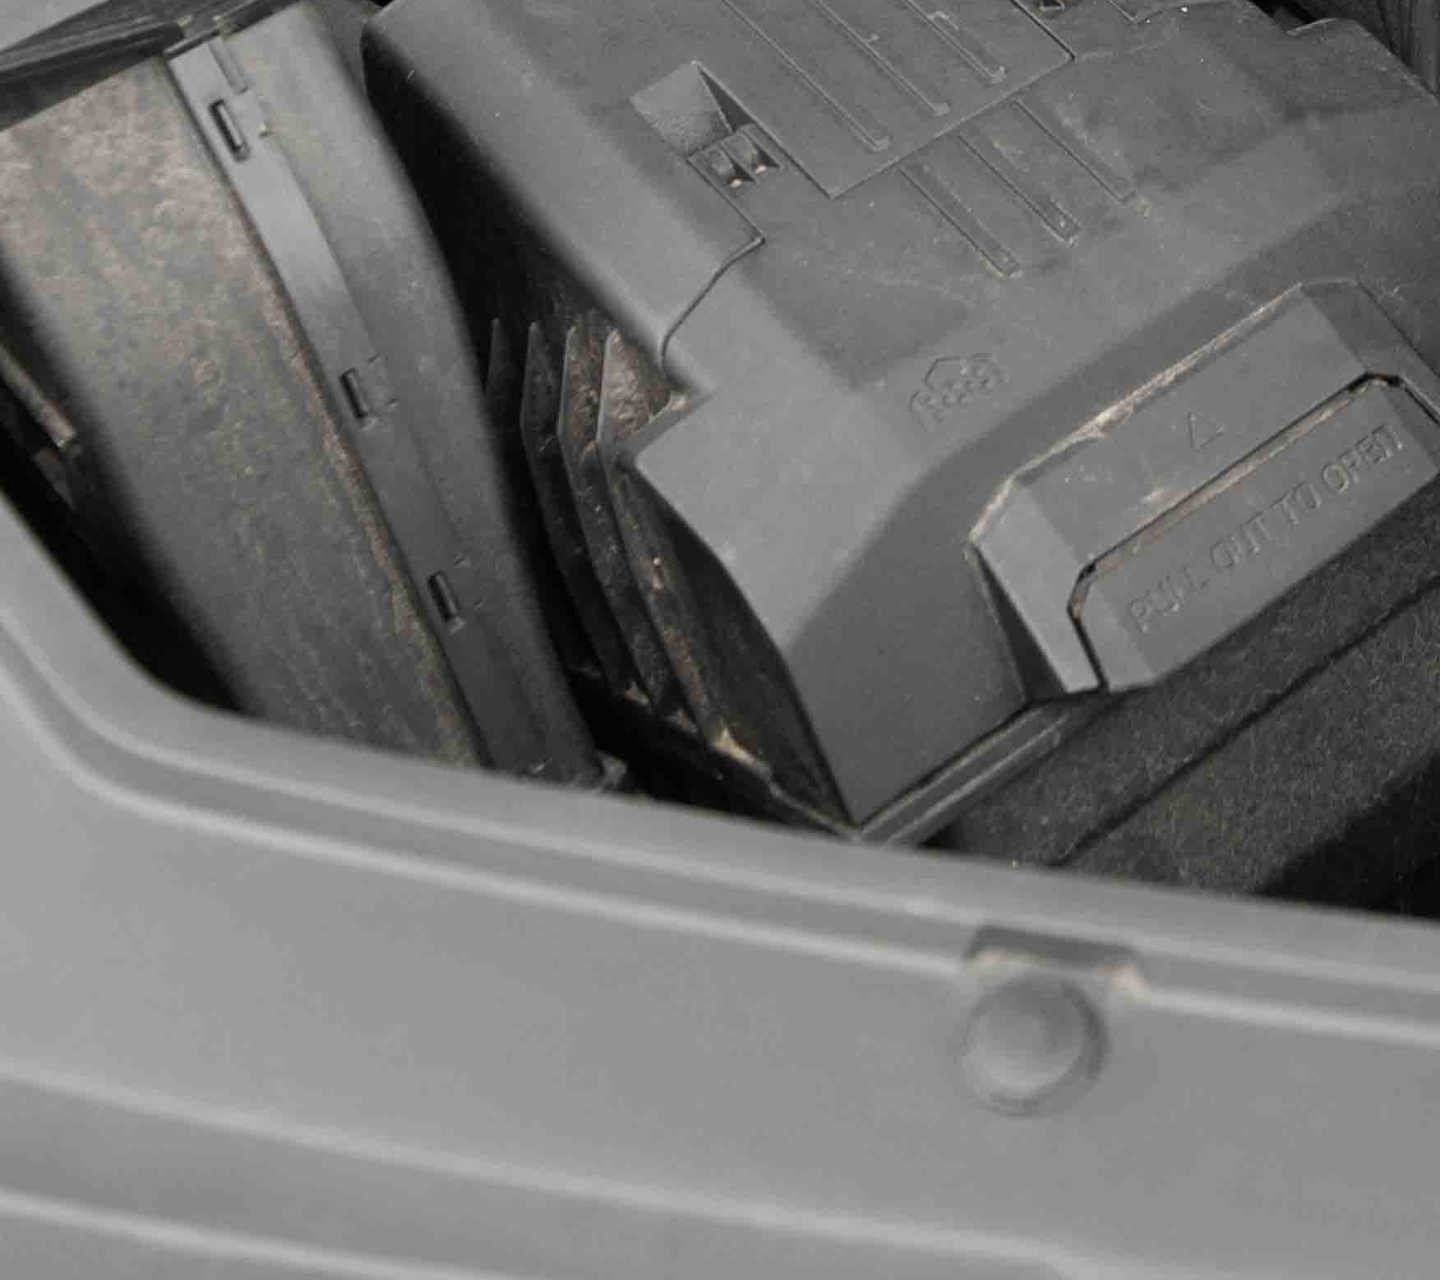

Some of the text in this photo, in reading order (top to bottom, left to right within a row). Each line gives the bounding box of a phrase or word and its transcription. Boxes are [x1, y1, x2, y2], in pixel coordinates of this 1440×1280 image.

[1210, 510, 1273, 569] OUT
[1272, 481, 1323, 527] TO
[1321, 424, 1405, 494] OPEN
